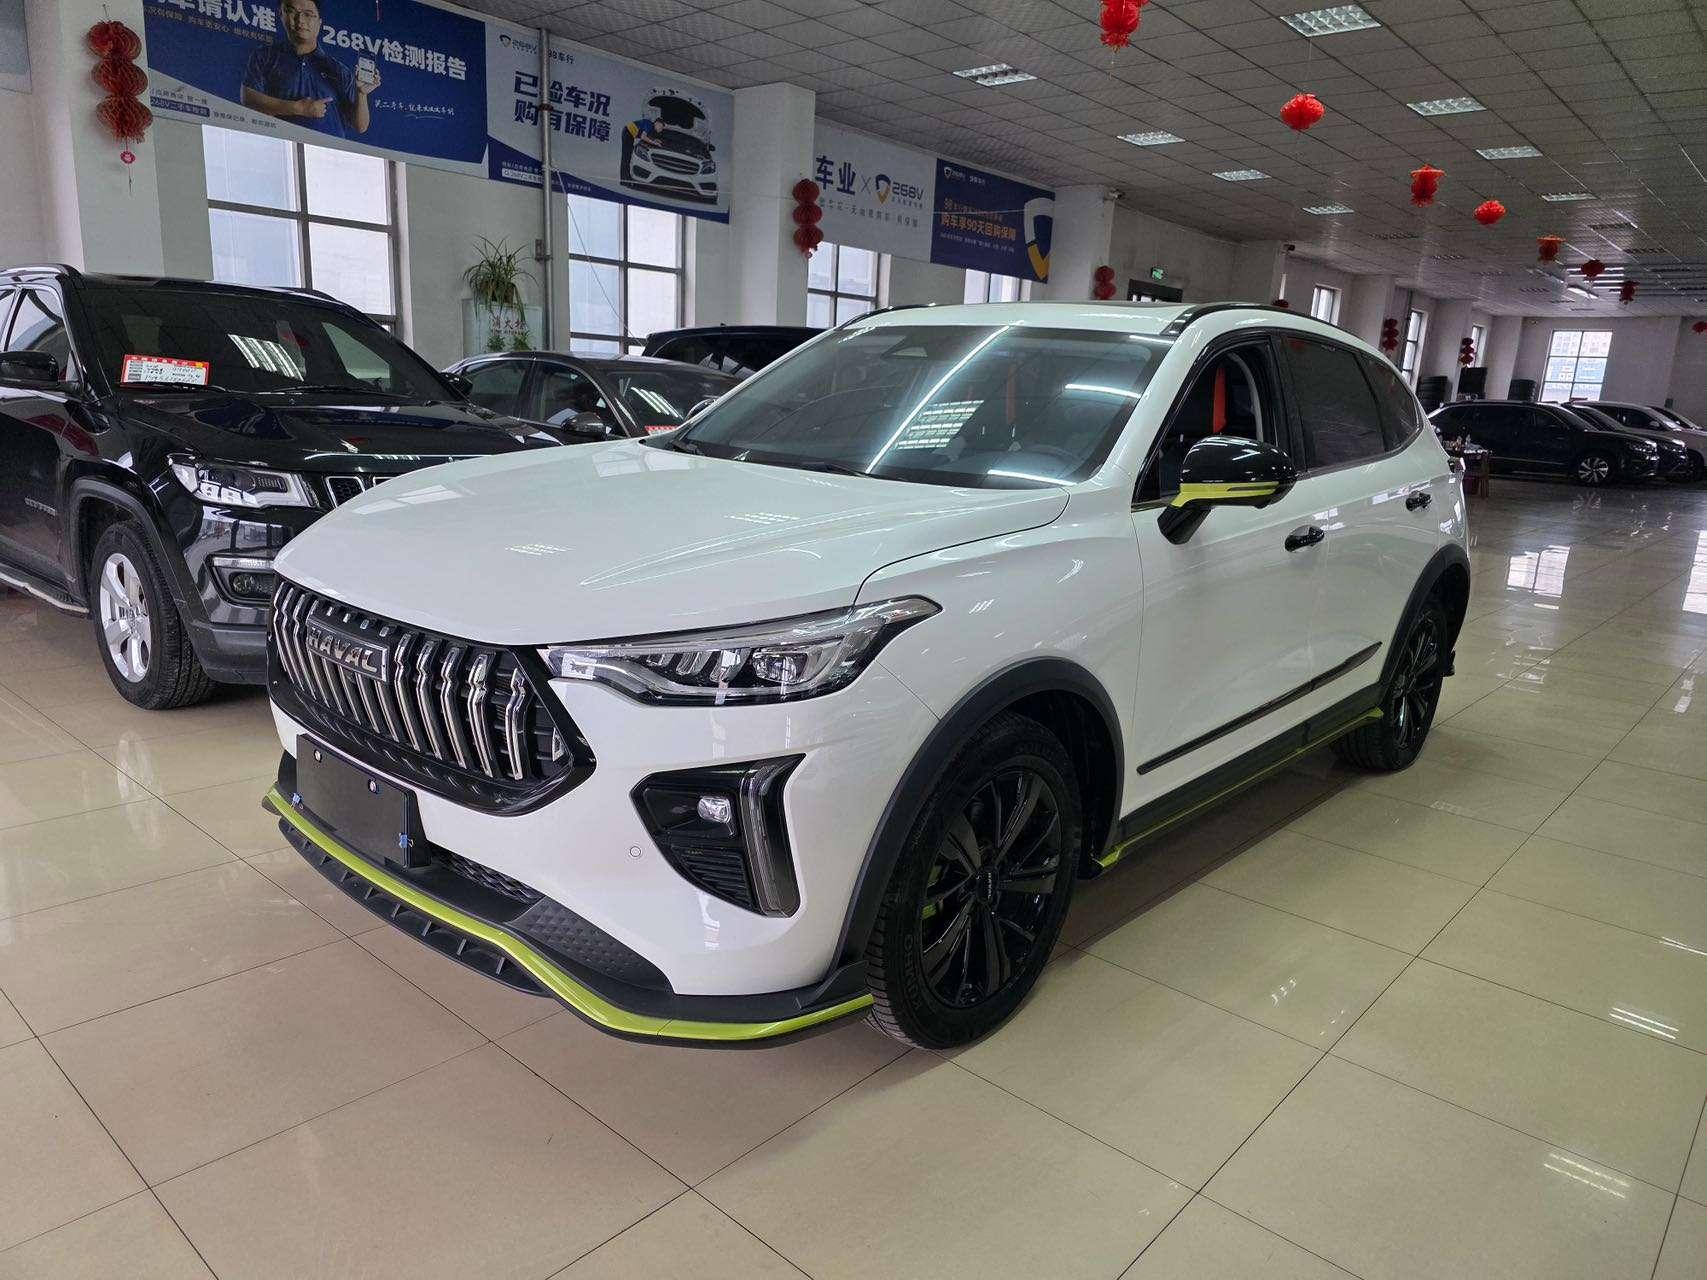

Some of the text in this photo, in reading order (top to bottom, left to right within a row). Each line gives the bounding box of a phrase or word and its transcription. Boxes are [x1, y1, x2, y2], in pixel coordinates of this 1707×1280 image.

[322, 25, 466, 80] 268V检测报告
[815, 155, 856, 195] 车业
[308, 626, 377, 673] HAVAL
